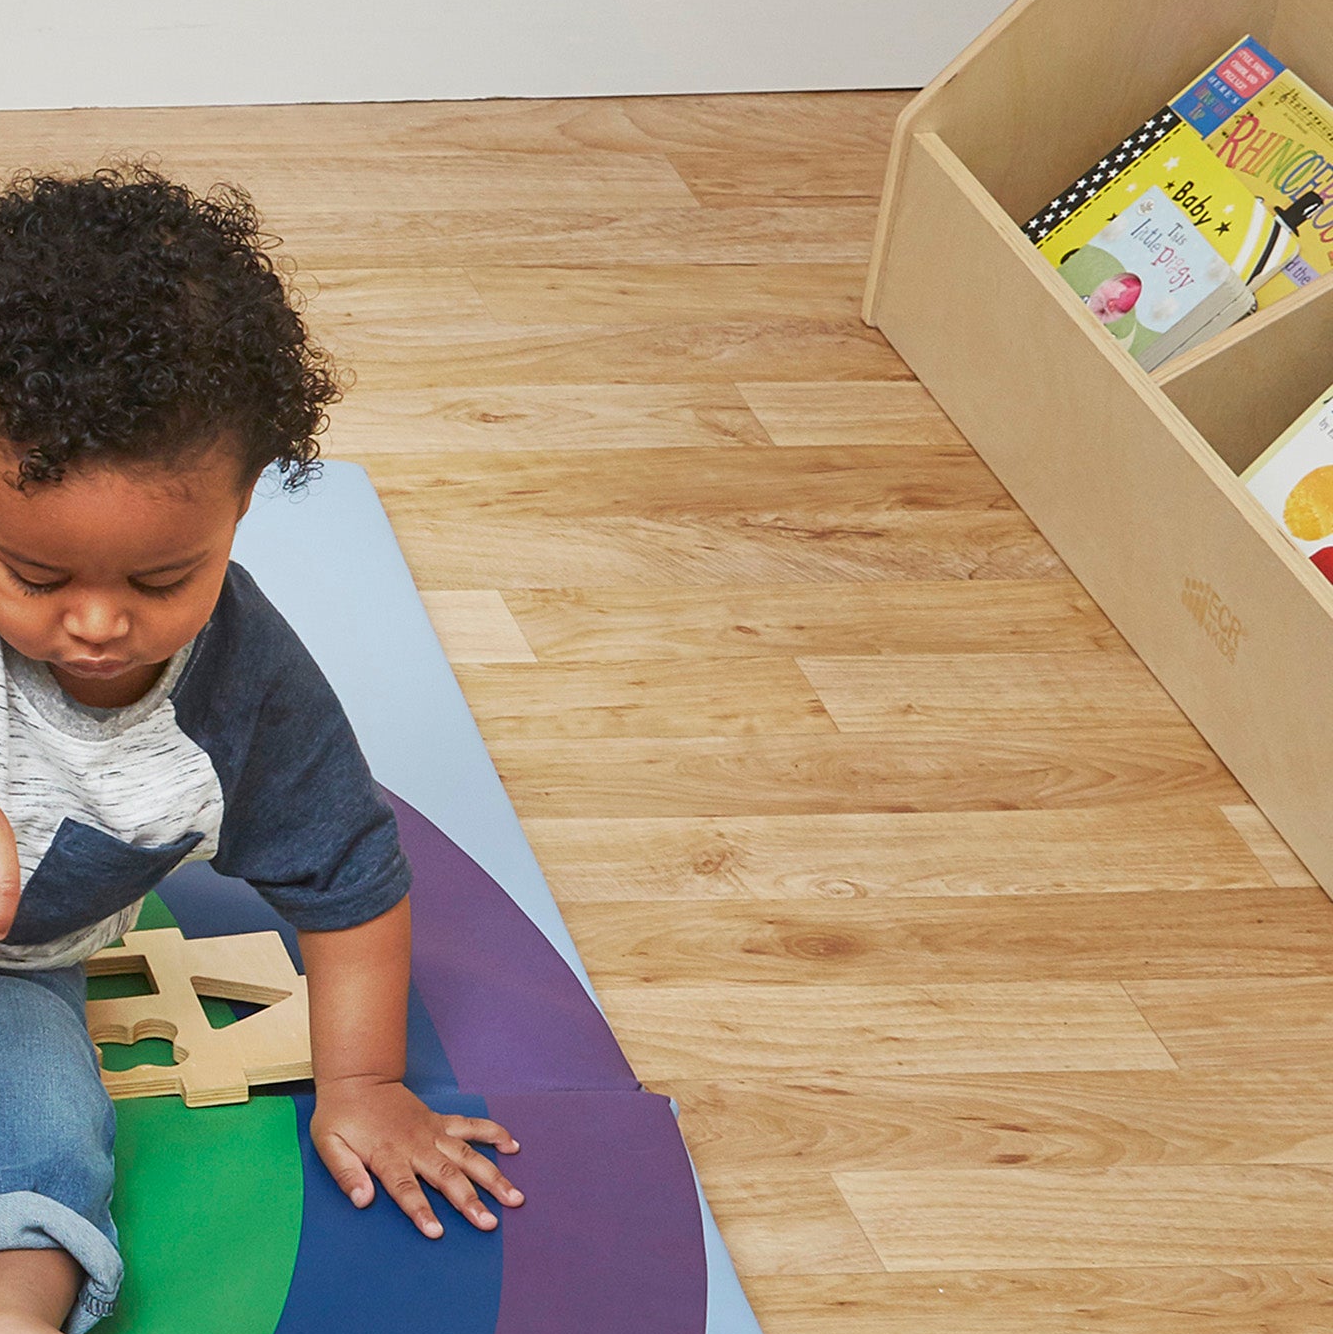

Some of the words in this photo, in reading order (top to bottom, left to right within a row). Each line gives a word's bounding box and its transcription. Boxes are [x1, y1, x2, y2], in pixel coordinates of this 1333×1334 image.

[1172, 181, 1212, 226] Baby
[1293, 267, 1311, 286] the
[1209, 590, 1242, 648] ECR
